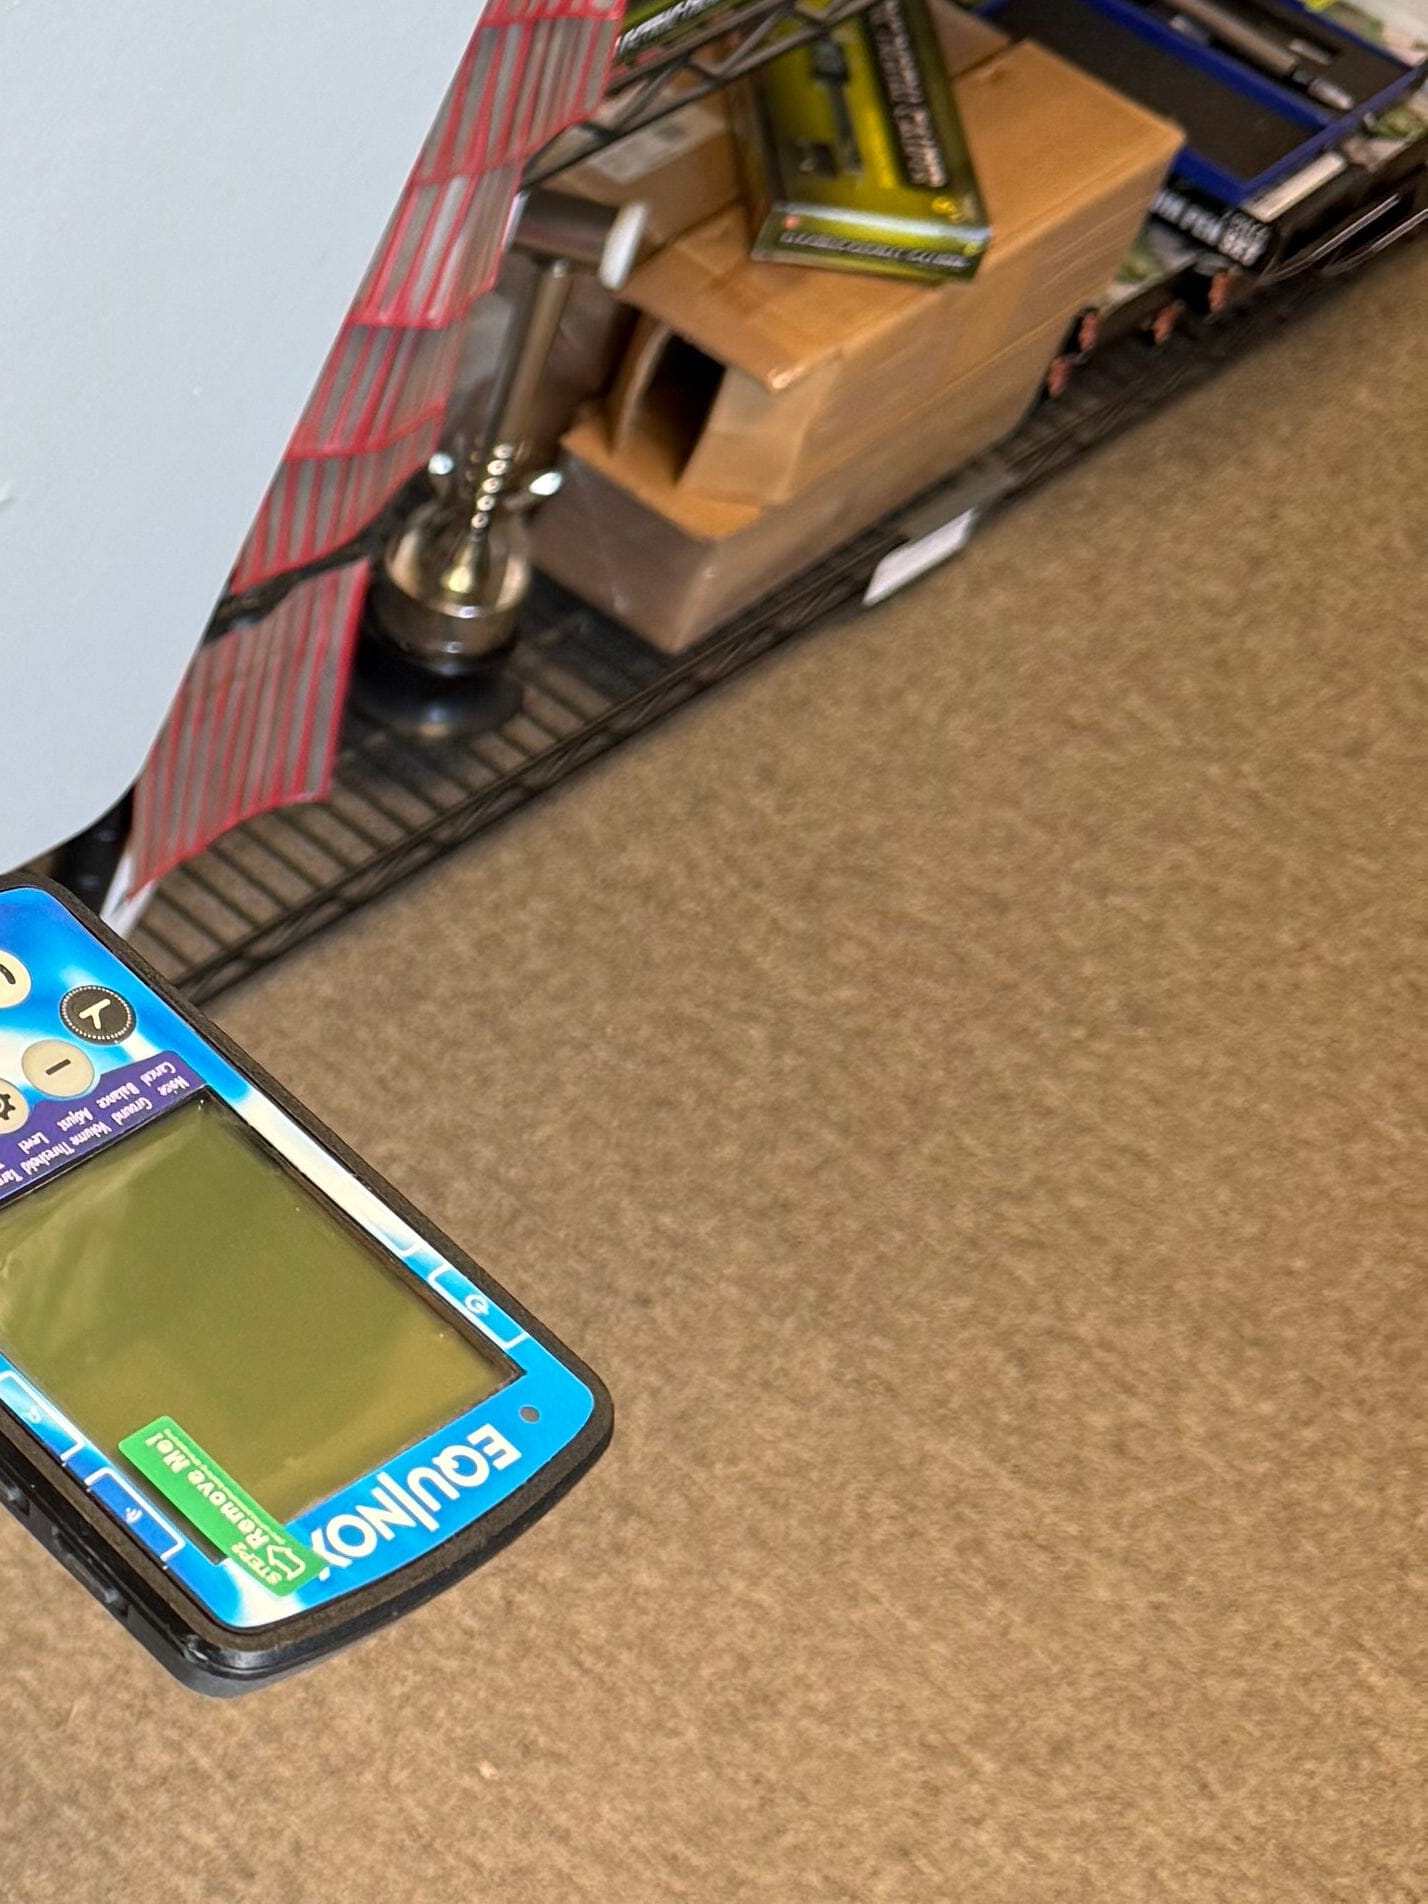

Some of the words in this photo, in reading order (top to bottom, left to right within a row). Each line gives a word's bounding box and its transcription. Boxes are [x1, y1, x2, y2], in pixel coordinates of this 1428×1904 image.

[139, 1060, 178, 1087] Cancel
[159, 1074, 191, 1098] Noise
[95, 1081, 141, 1111] Balance
[56, 1106, 94, 1132] Adjust
[110, 1097, 154, 1126] Ground
[17, 1131, 51, 1155] Level
[69, 1118, 113, 1147] Volume
[21, 1140, 76, 1176] Threshold
[144, 1429, 187, 1475] Me!
[187, 1466, 271, 1552] Remove
